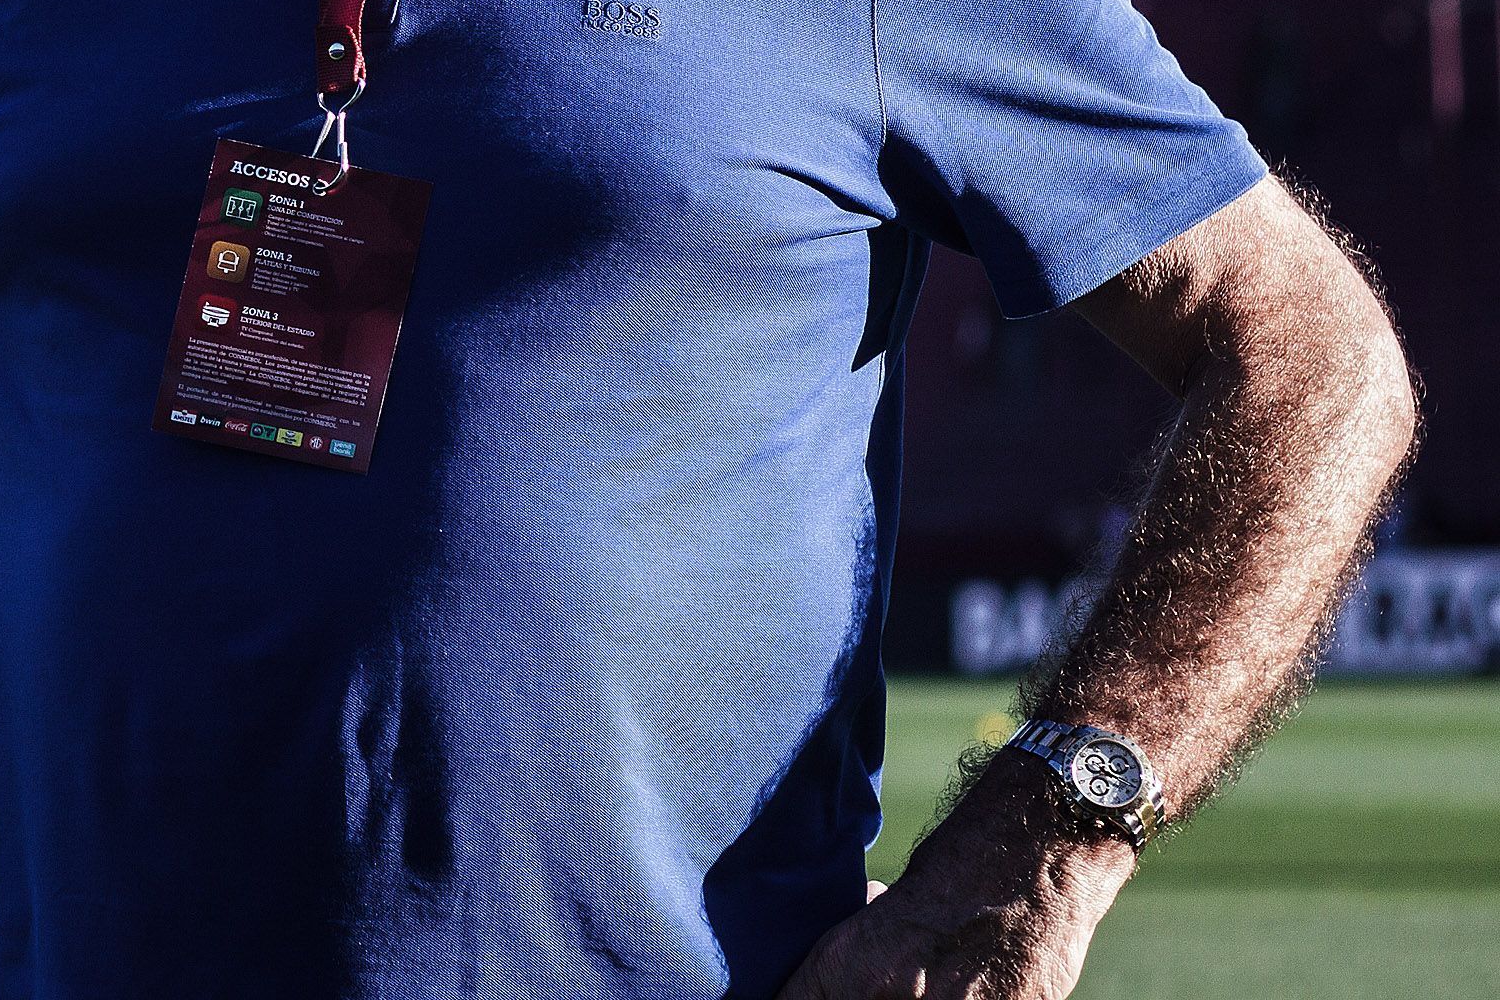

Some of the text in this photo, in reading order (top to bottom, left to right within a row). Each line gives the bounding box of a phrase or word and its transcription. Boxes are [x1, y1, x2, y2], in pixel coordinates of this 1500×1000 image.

[581, 15, 621, 33] HUGO
[230, 160, 311, 189] ACCESOS
[267, 205, 287, 214] ZONA
[269, 195, 305, 209] ZONA 1
[256, 248, 293, 262] ZONA 2
[254, 258, 283, 269] PLATEAS
[288, 265, 321, 277] TRIBUNAS
[242, 306, 279, 321] ZONA 3
[240, 316, 315, 337] EXTERIOR DEL ESTADIO
[200, 416, 221, 427] bwin
